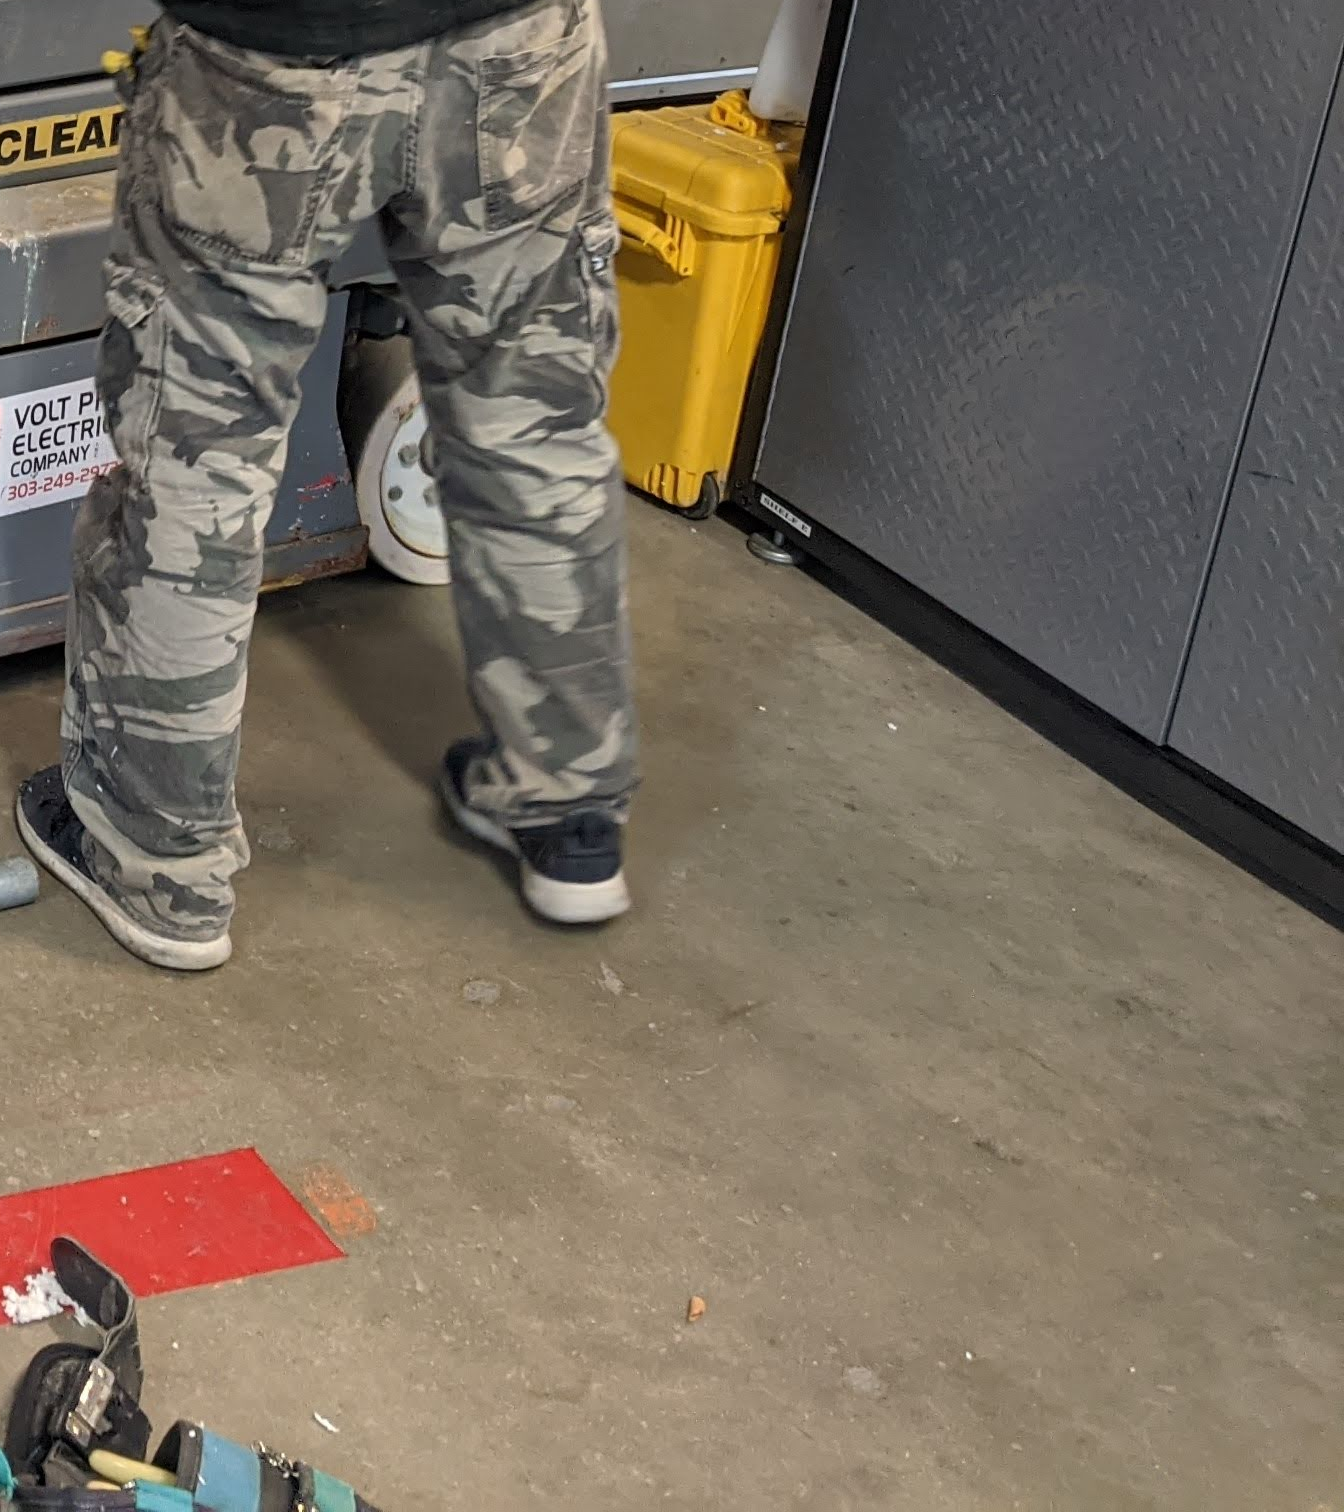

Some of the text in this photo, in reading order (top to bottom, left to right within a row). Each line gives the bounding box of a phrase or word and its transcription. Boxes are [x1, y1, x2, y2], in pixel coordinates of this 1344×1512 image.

[14, 390, 101, 430] VOLT P
[10, 443, 91, 478] COMPANY
[7, 461, 124, 502] 303-249-297
